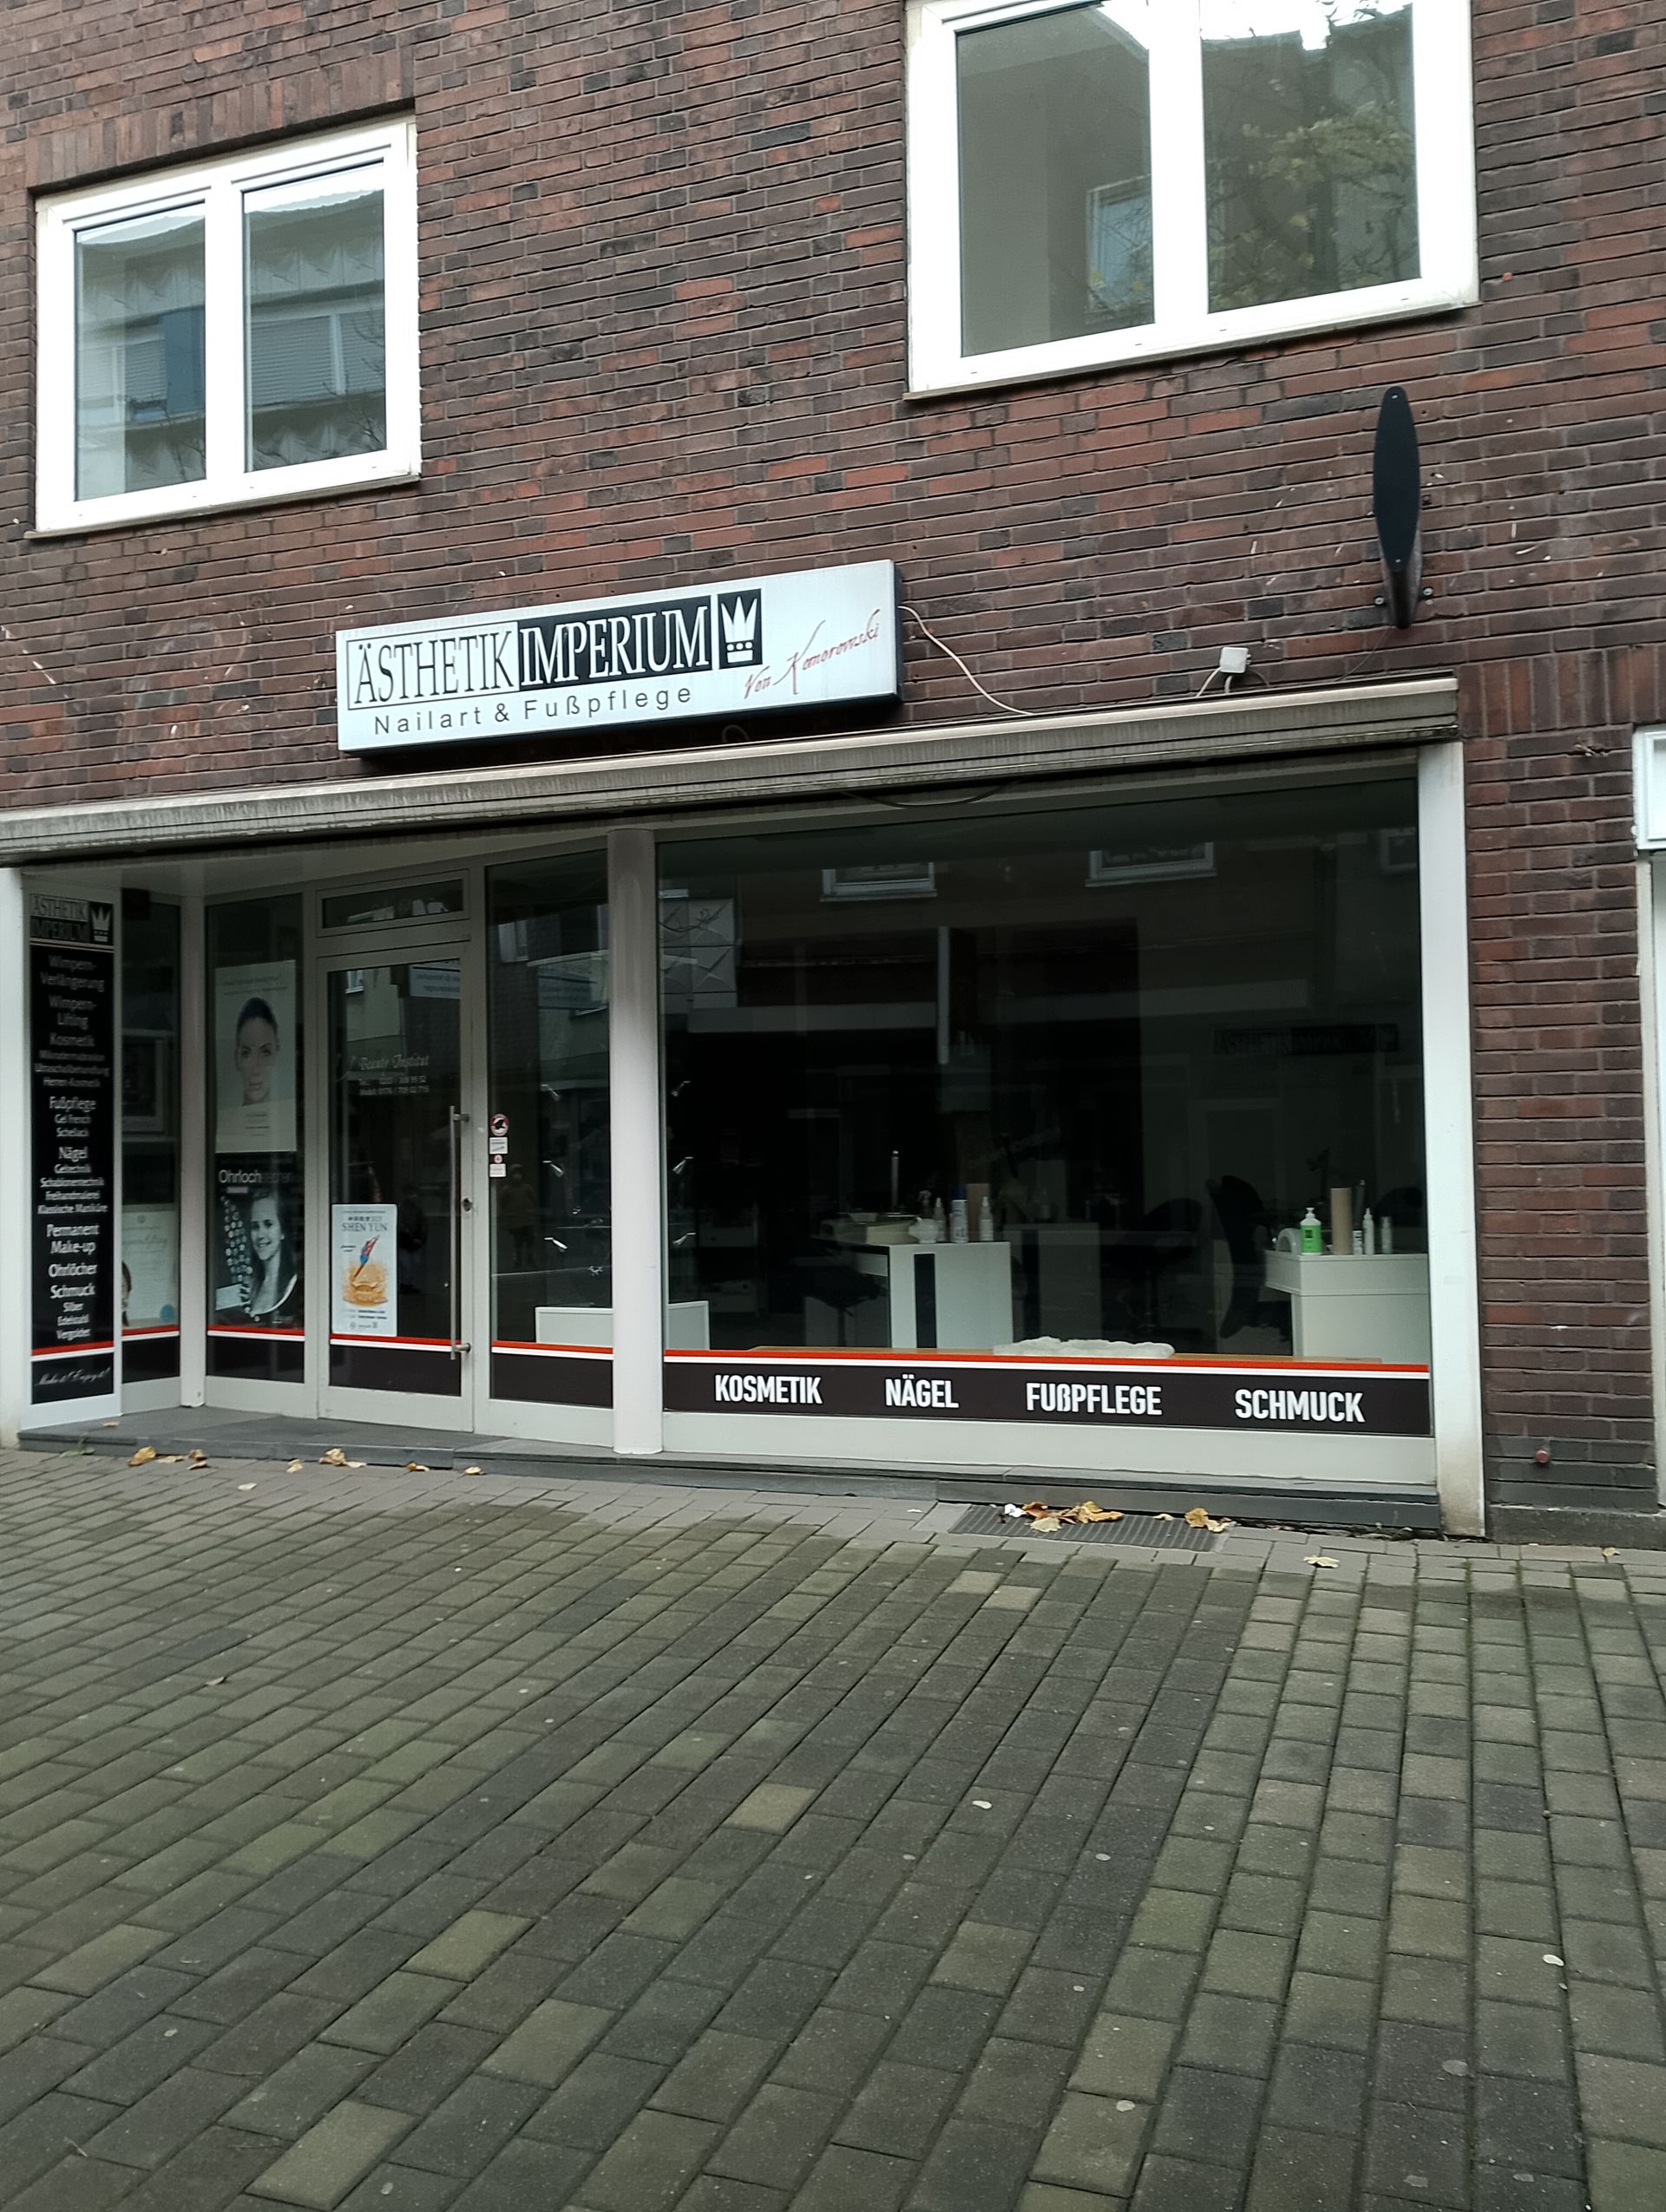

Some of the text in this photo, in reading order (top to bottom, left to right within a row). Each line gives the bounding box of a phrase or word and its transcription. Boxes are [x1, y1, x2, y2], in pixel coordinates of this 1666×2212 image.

[354, 606, 709, 704] ÄSTHETIK IMPERIUM
[744, 665, 771, 699] Von
[375, 688, 691, 735] Nailart & Fußpflege
[49, 1096, 96, 1112] Fußpflege
[59, 1146, 88, 1162] Nägel
[47, 1224, 100, 1237] Permanent
[341, 1222, 387, 1232] SHEN YUN
[50, 1240, 95, 1255] Make-up
[49, 1262, 97, 1277] Ohrlöcher
[50, 1283, 95, 1299] Schmuck
[714, 1373, 1366, 1423] KOSMETIK NÄGEL FUßPFLEGE SCHMUCK
